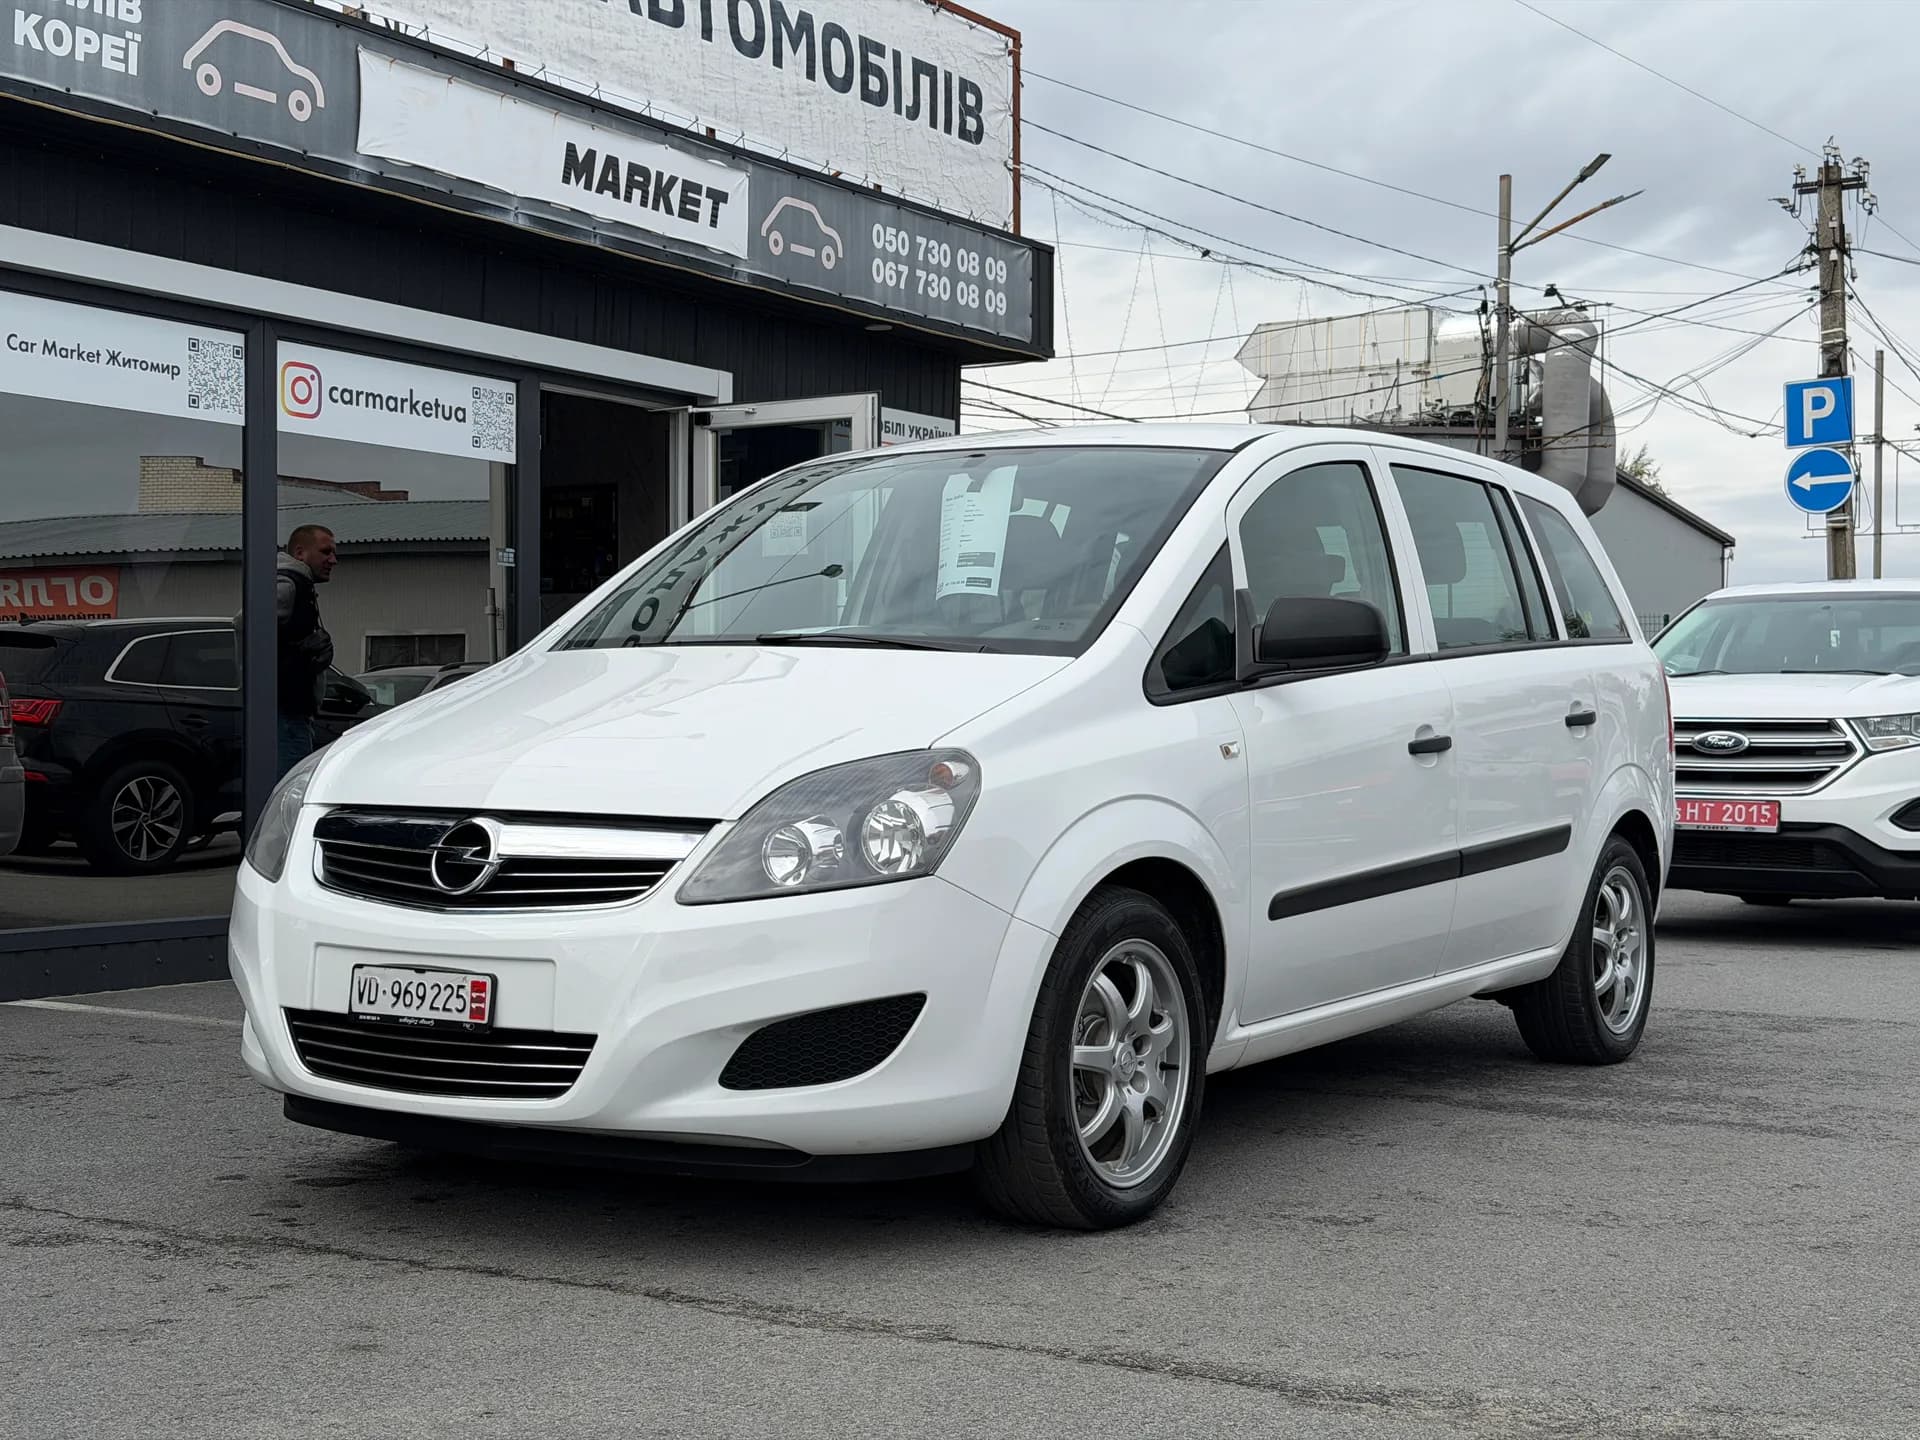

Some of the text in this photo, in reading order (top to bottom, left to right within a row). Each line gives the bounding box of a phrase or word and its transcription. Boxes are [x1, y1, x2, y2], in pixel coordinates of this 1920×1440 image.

[14, 8, 142, 76] КОРЕЇ
[629, 0, 984, 146] ОМОБІЛІВ
[561, 141, 729, 229] MARKET
[872, 223, 1007, 284] 050 730 08 09
[872, 257, 1007, 316] 067 730 08 09
[6, 333, 181, 381] Car Market Житомир
[328, 385, 467, 423] carmarketua
[908, 424, 953, 440] УКРАЇН
[1802, 386, 1836, 439] P
